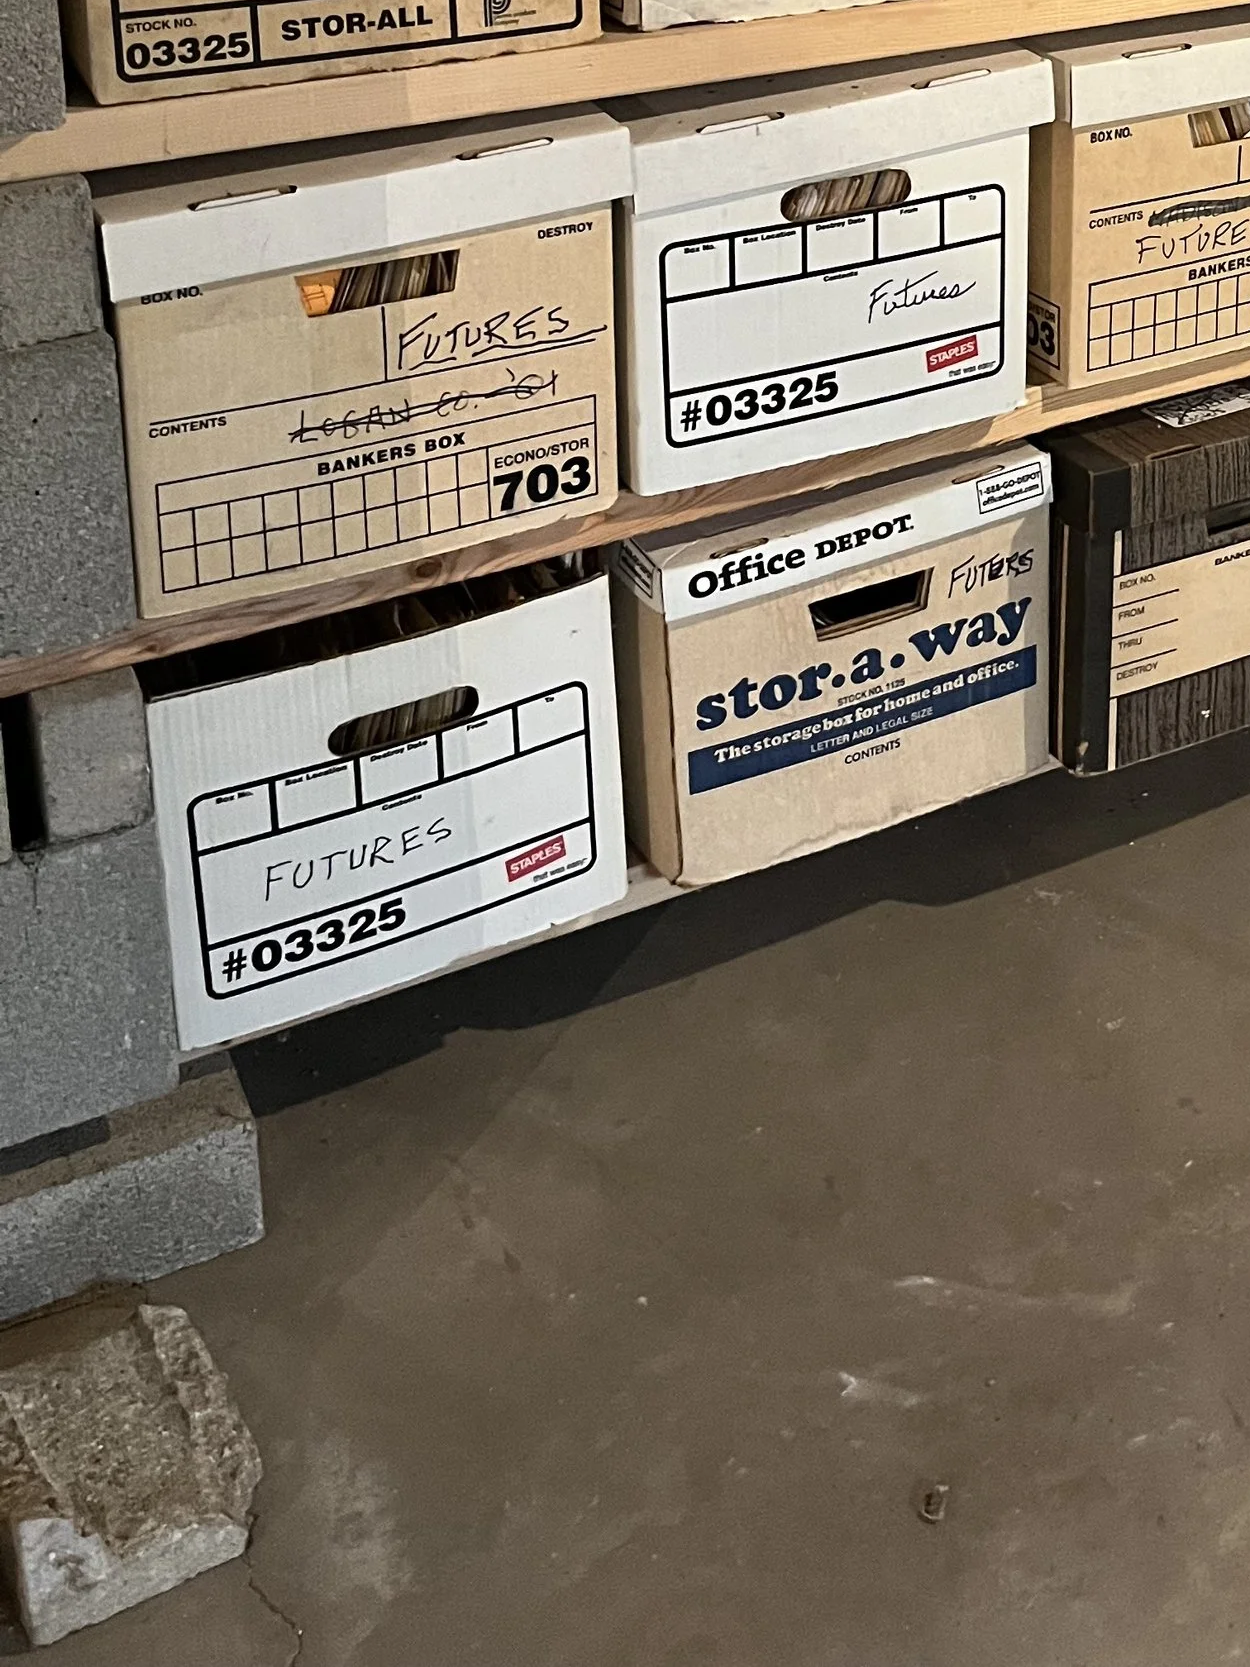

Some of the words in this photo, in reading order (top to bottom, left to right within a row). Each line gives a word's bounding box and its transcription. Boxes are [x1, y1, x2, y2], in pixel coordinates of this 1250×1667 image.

[280, 6, 432, 40] STOR-ALL
[125, 32, 251, 70] 03325
[538, 221, 594, 239] DESTROY
[1089, 211, 1143, 229] CONTENTS
[868, 271, 976, 324] Futures
[398, 305, 569, 369] FUTURES
[929, 340, 975, 367] STAPLES
[681, 371, 839, 432] #03325
[149, 417, 227, 439] CONTENTS
[317, 443, 416, 476] BANKERS
[424, 433, 465, 454] BOX
[494, 437, 589, 469] ECONO/STOR
[492, 456, 591, 511] 703
[688, 550, 805, 599] Office
[815, 514, 914, 560] DEPOT
[948, 548, 1034, 598] FUTERS
[714, 742, 751, 764] The
[752, 720, 821, 751] storage
[823, 709, 853, 731] box
[854, 702, 882, 721] for
[884, 690, 930, 713] home
[932, 677, 964, 696] and
[967, 661, 1019, 683] office.
[810, 733, 850, 753] LETTER
[853, 726, 873, 741] AND
[876, 716, 908, 734] LEGAL
[911, 706, 934, 721] SIZE
[844, 738, 901, 764] CONTENTS
[264, 816, 452, 901] FUTURES
[510, 842, 563, 875] STAPLES
[223, 897, 406, 982] #03325
